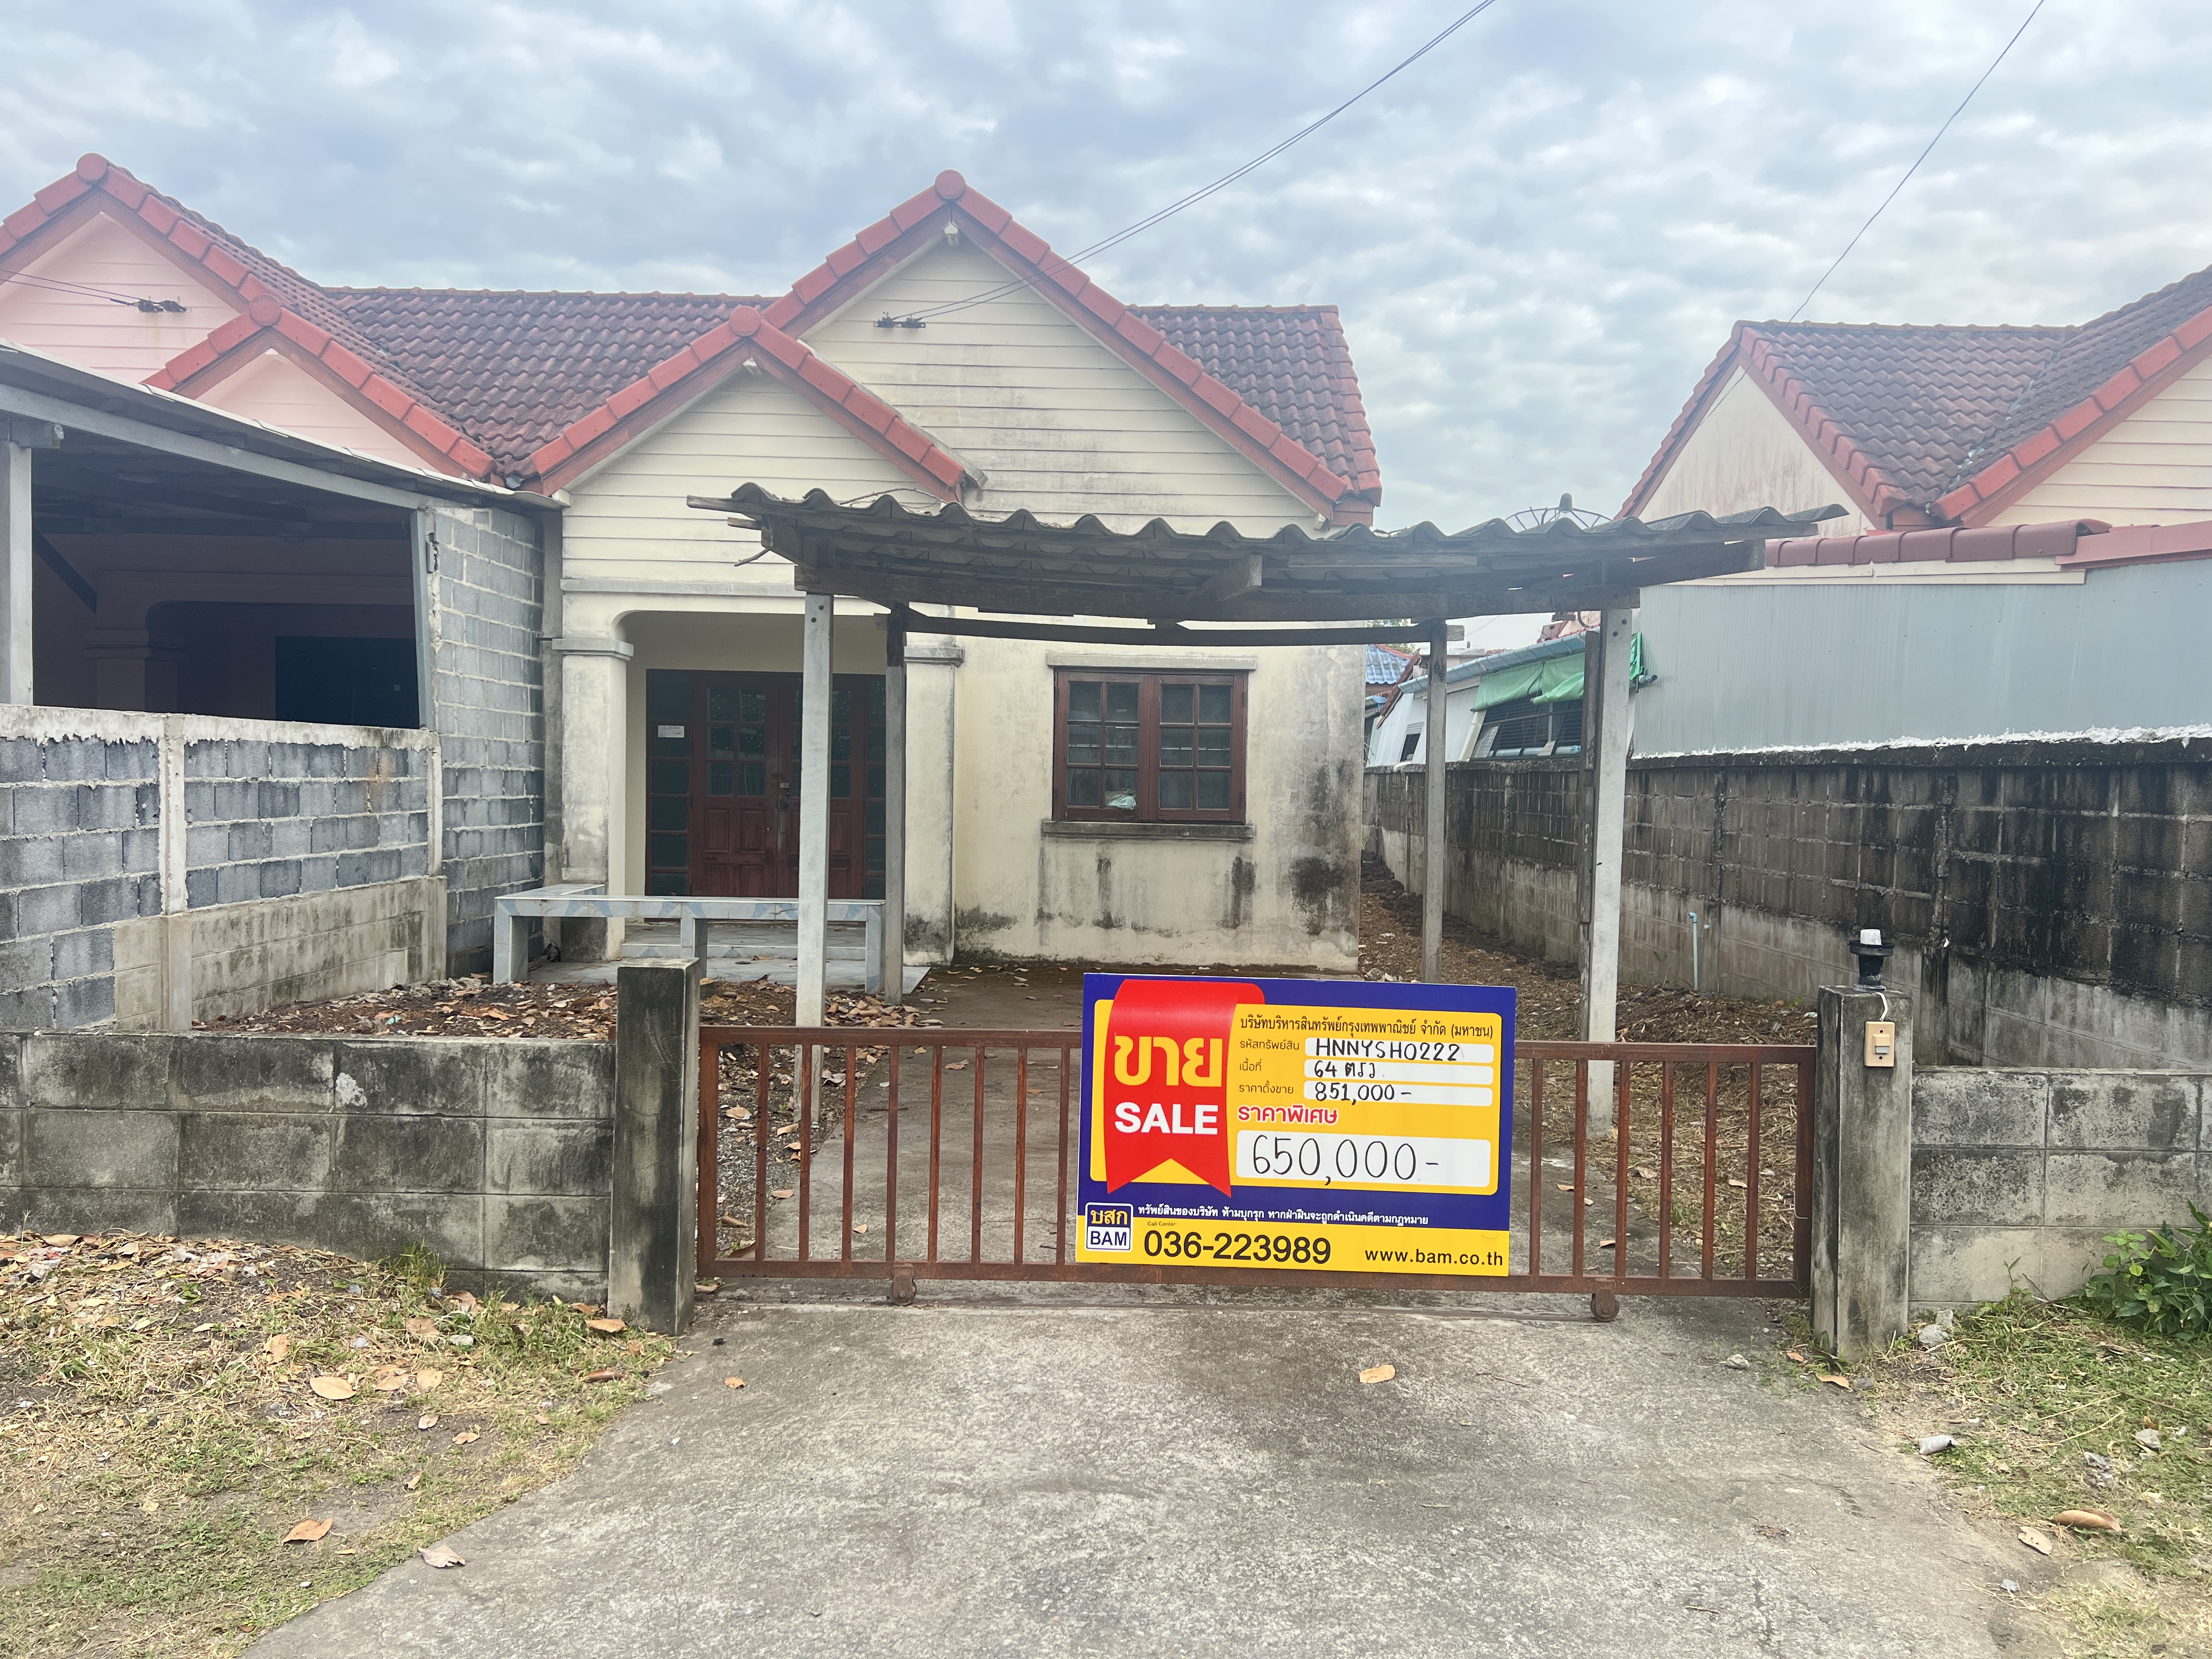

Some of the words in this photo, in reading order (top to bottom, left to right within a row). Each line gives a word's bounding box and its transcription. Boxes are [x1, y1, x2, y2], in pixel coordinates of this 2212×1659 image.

[1240, 1014, 1417, 1037] บริษัทบริหารสินทรัพย์กรุงเทพพาณิชย์
[1420, 1019, 1446, 1035] จำกัด
[1451, 1024, 1493, 1040] (มหาชน)
[1240, 1038, 1300, 1051] รหัสทรัพย์สิน
[1114, 1035, 1223, 1087] ขาย
[1239, 1058, 1262, 1071] เนื้อที่
[1314, 1060, 1338, 1077] 64
[1239, 1080, 1294, 1094] ราคาตั้งขาย
[1114, 1101, 1218, 1135] SALE
[1238, 1104, 1339, 1124] ราคาพิเศษ
[1090, 1209, 1128, 1226] บสก
[1138, 1203, 1218, 1217] ทรัพย์สินของบริษัท
[1222, 1206, 1265, 1221] ห้ามบุกรุก
[1267, 1208, 1429, 1226] หากฝ่าฝืนจะถูกดำเนินคดีตามกฎหมาย
[1090, 1231, 1127, 1246] BAM
[1144, 1229, 1331, 1265] 036-223989
[1364, 1249, 1503, 1266] www.bam.co.th
